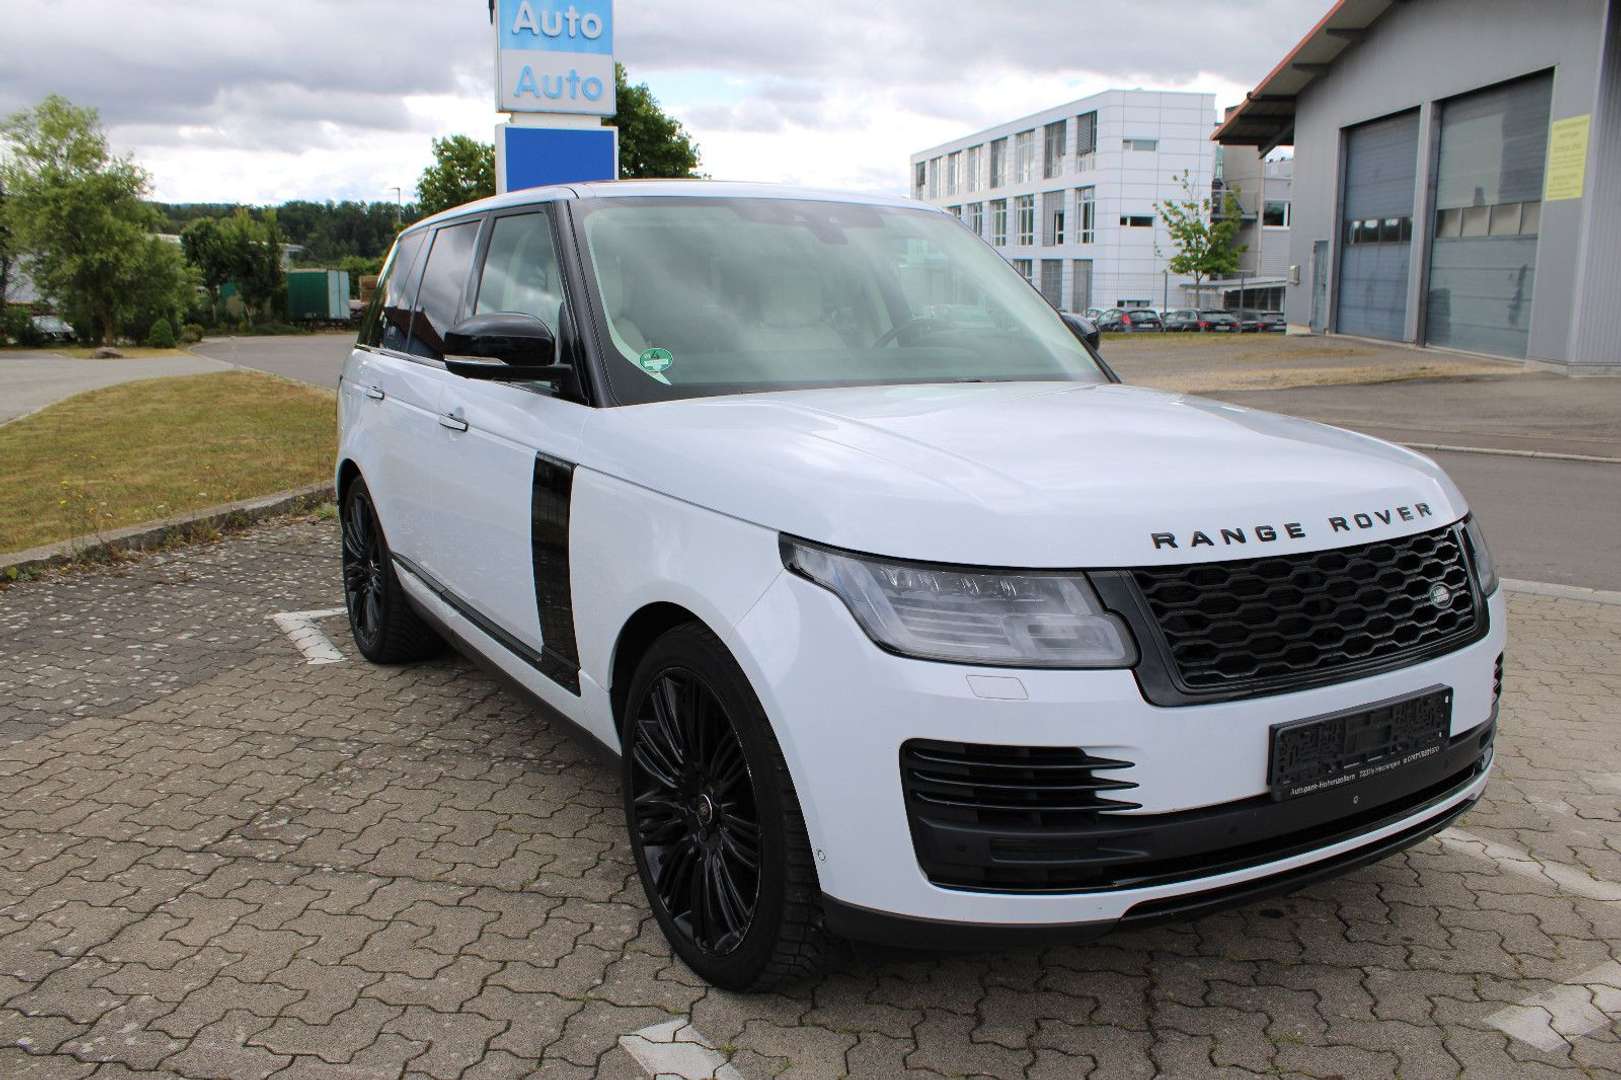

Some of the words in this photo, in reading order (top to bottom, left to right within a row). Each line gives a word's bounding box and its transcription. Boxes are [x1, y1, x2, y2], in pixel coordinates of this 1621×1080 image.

[512, 0, 603, 40] Auto
[513, 64, 604, 101] Auto
[1151, 522, 1306, 550] RANGE
[1328, 502, 1433, 533] ROVER
